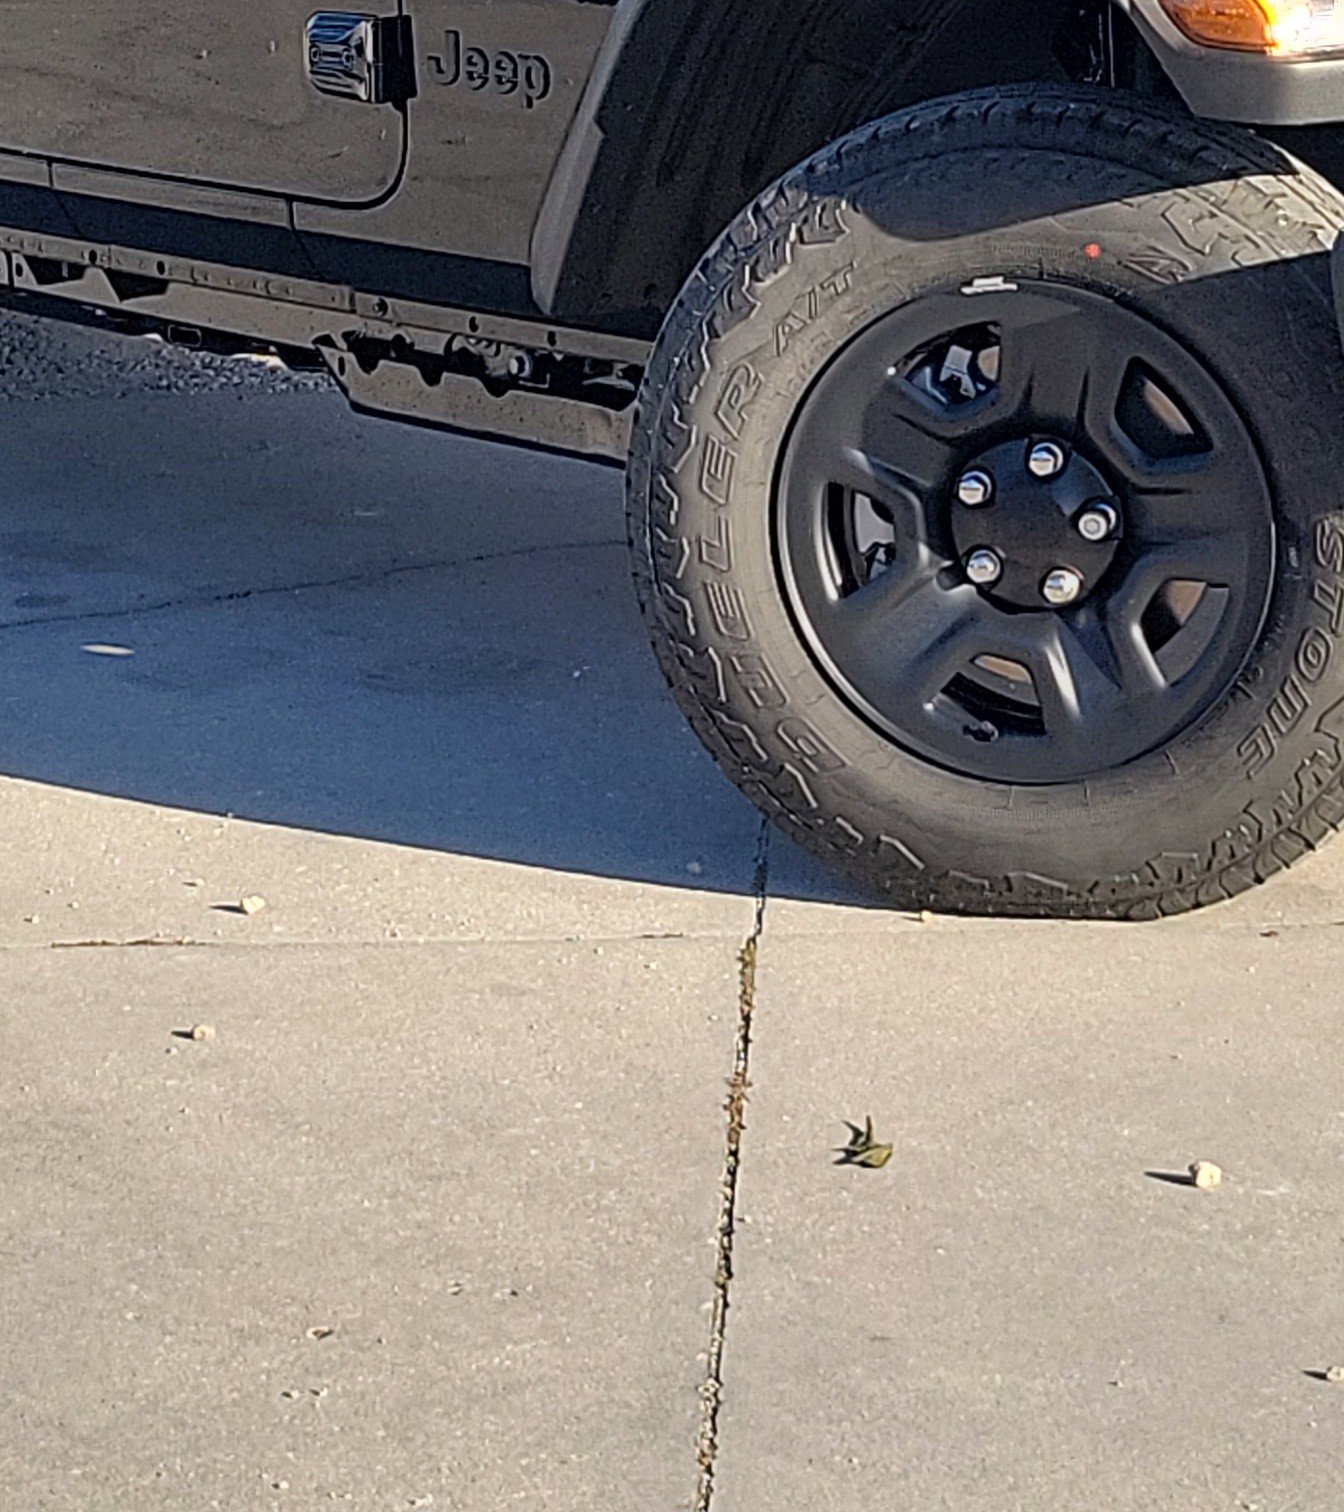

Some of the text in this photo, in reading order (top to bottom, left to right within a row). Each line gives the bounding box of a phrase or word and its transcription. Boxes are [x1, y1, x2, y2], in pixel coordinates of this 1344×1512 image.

[427, 29, 551, 109] Jeep
[699, 260, 857, 774] DUELER A/T
